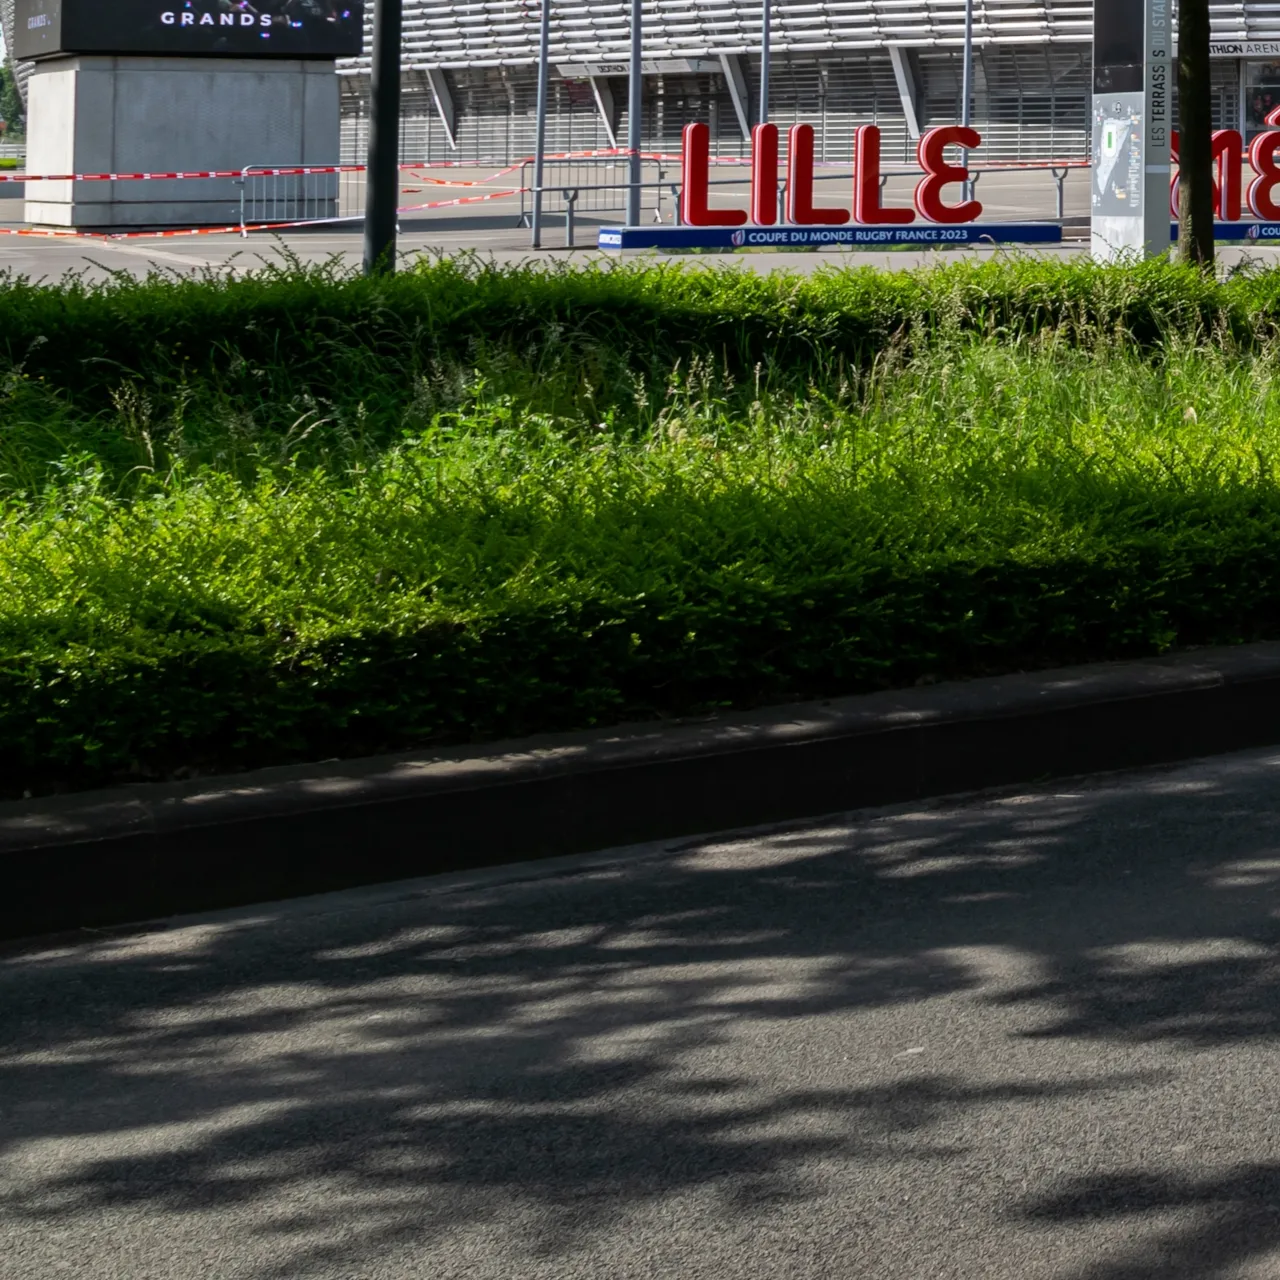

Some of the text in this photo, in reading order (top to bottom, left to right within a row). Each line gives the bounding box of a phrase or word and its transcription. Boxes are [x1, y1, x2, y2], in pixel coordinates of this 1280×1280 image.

[161, 11, 272, 27] GRANDS
[1152, 31, 1165, 46] DU
[1210, 44, 1243, 53] THLON
[1152, 127, 1165, 147] LES
[681, 123, 982, 226] LILLE
[749, 230, 968, 243] COUPE DU MONDE RUGBY FRANCE 2023
